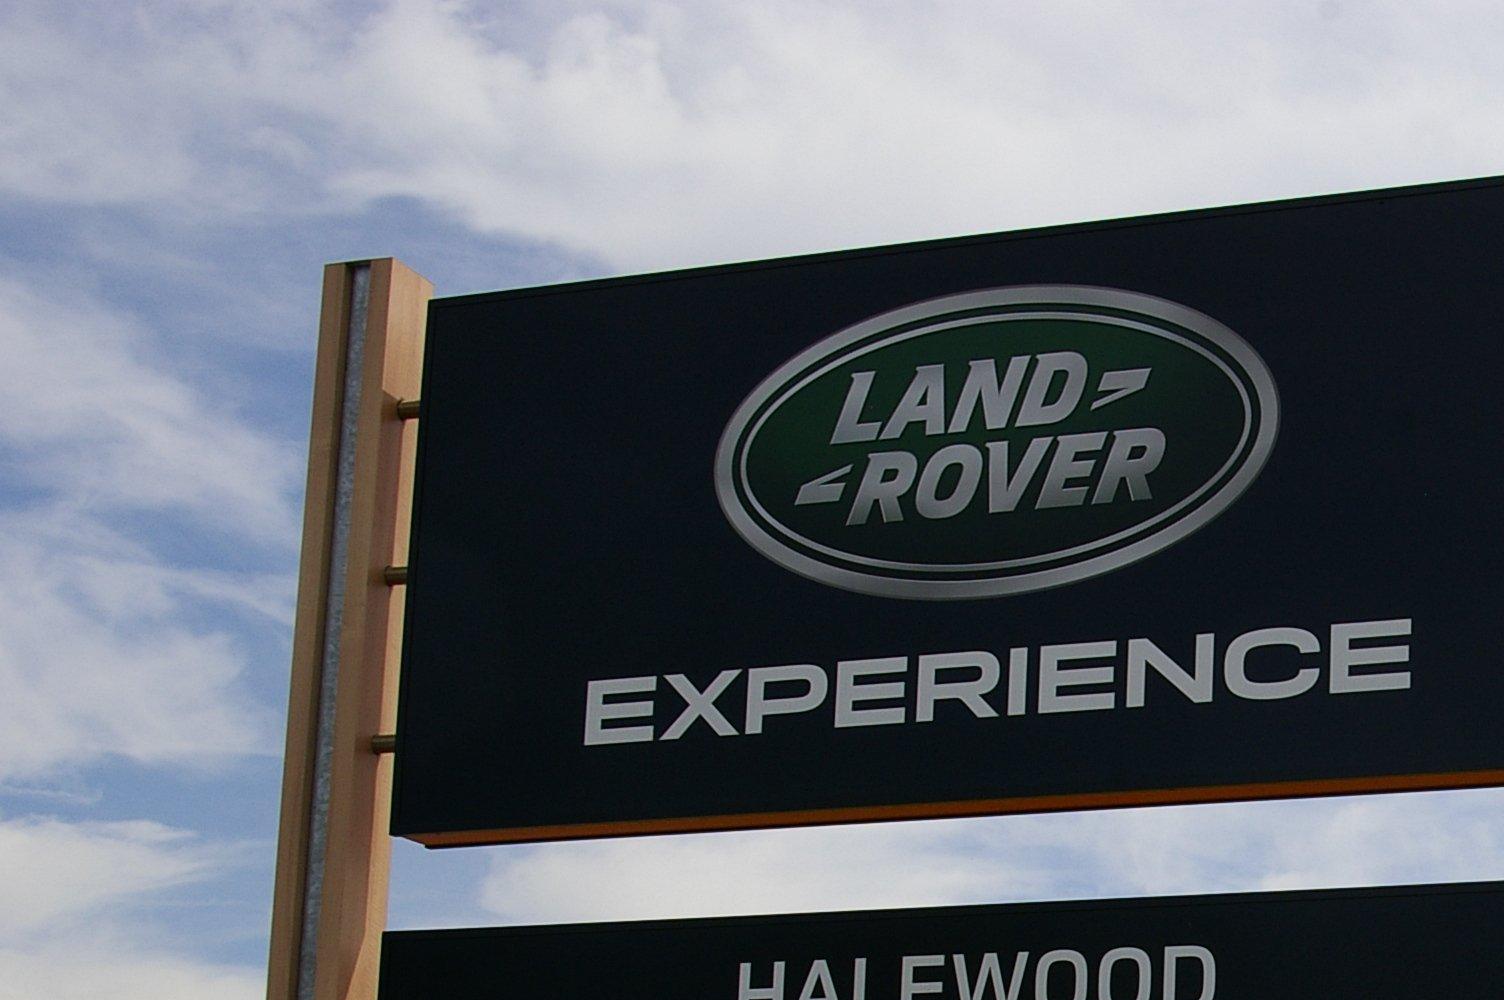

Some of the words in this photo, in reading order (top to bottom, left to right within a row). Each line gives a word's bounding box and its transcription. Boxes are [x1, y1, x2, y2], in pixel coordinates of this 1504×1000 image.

[830, 350, 1089, 445] LAND
[845, 426, 1166, 526] ROVER
[583, 617, 1413, 746] EXPERIENCE
